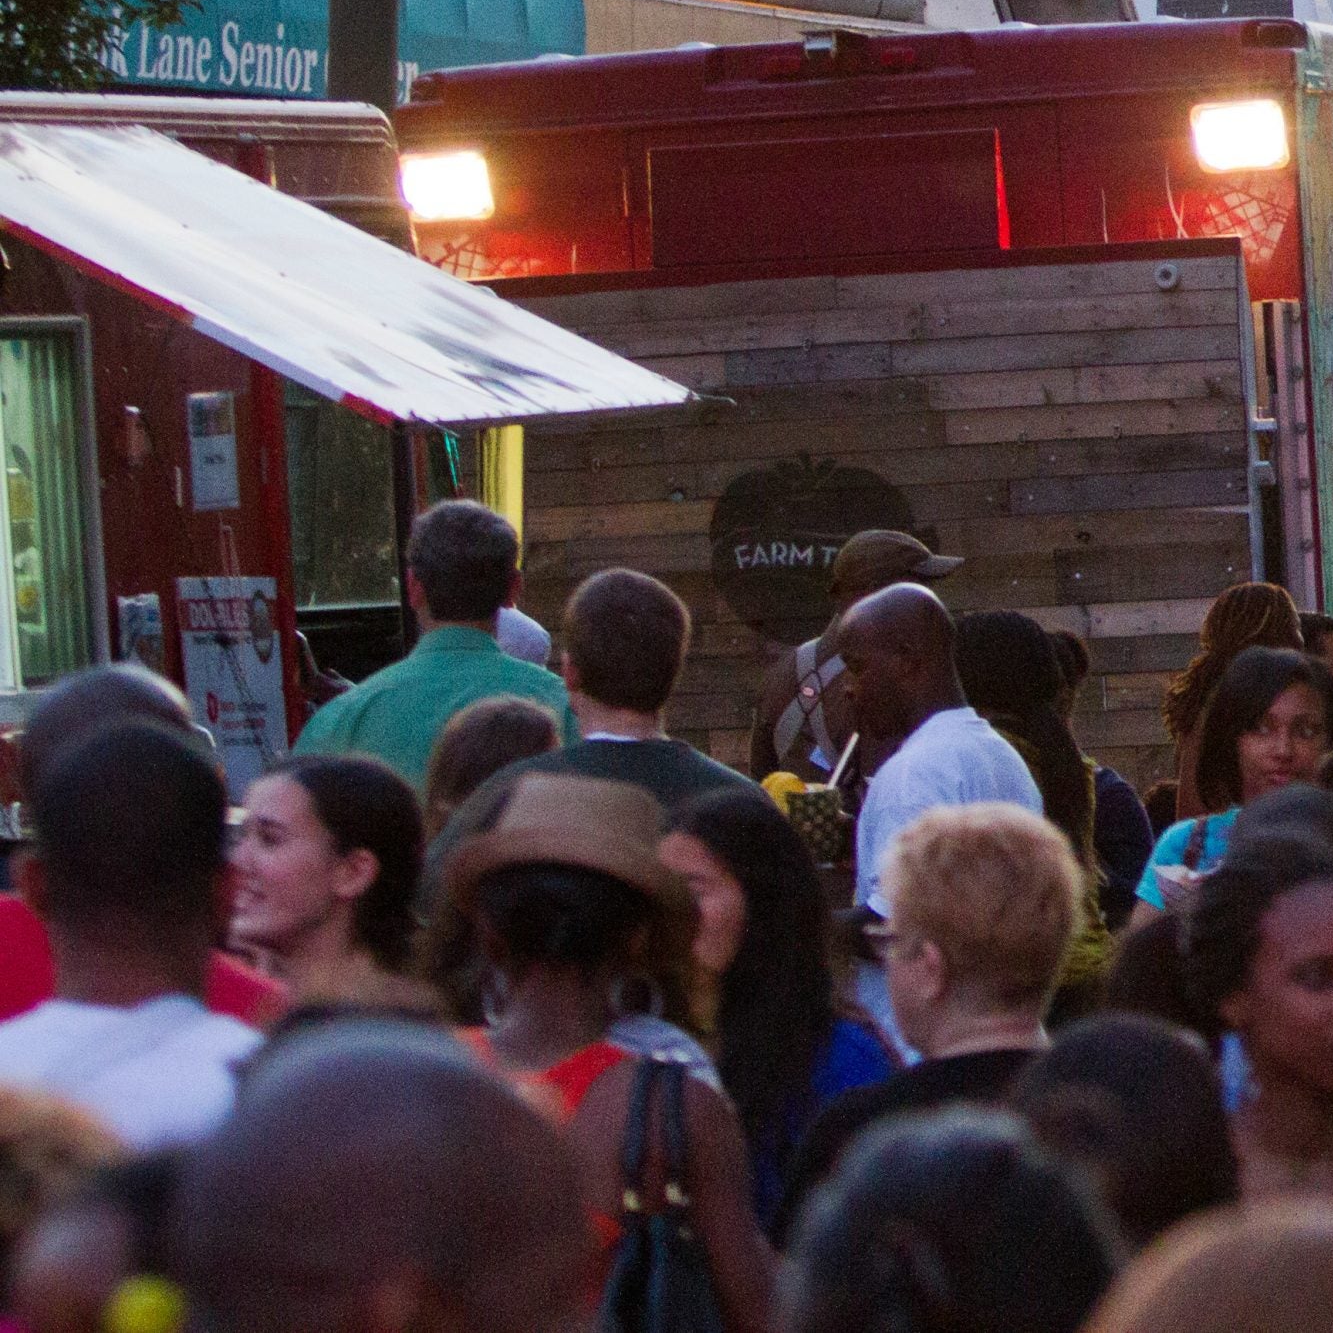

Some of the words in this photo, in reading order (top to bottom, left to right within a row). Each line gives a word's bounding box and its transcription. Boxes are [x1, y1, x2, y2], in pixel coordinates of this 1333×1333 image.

[137, 19, 211, 84] Lane
[219, 21, 317, 92] Senior
[734, 541, 814, 568] FARM
